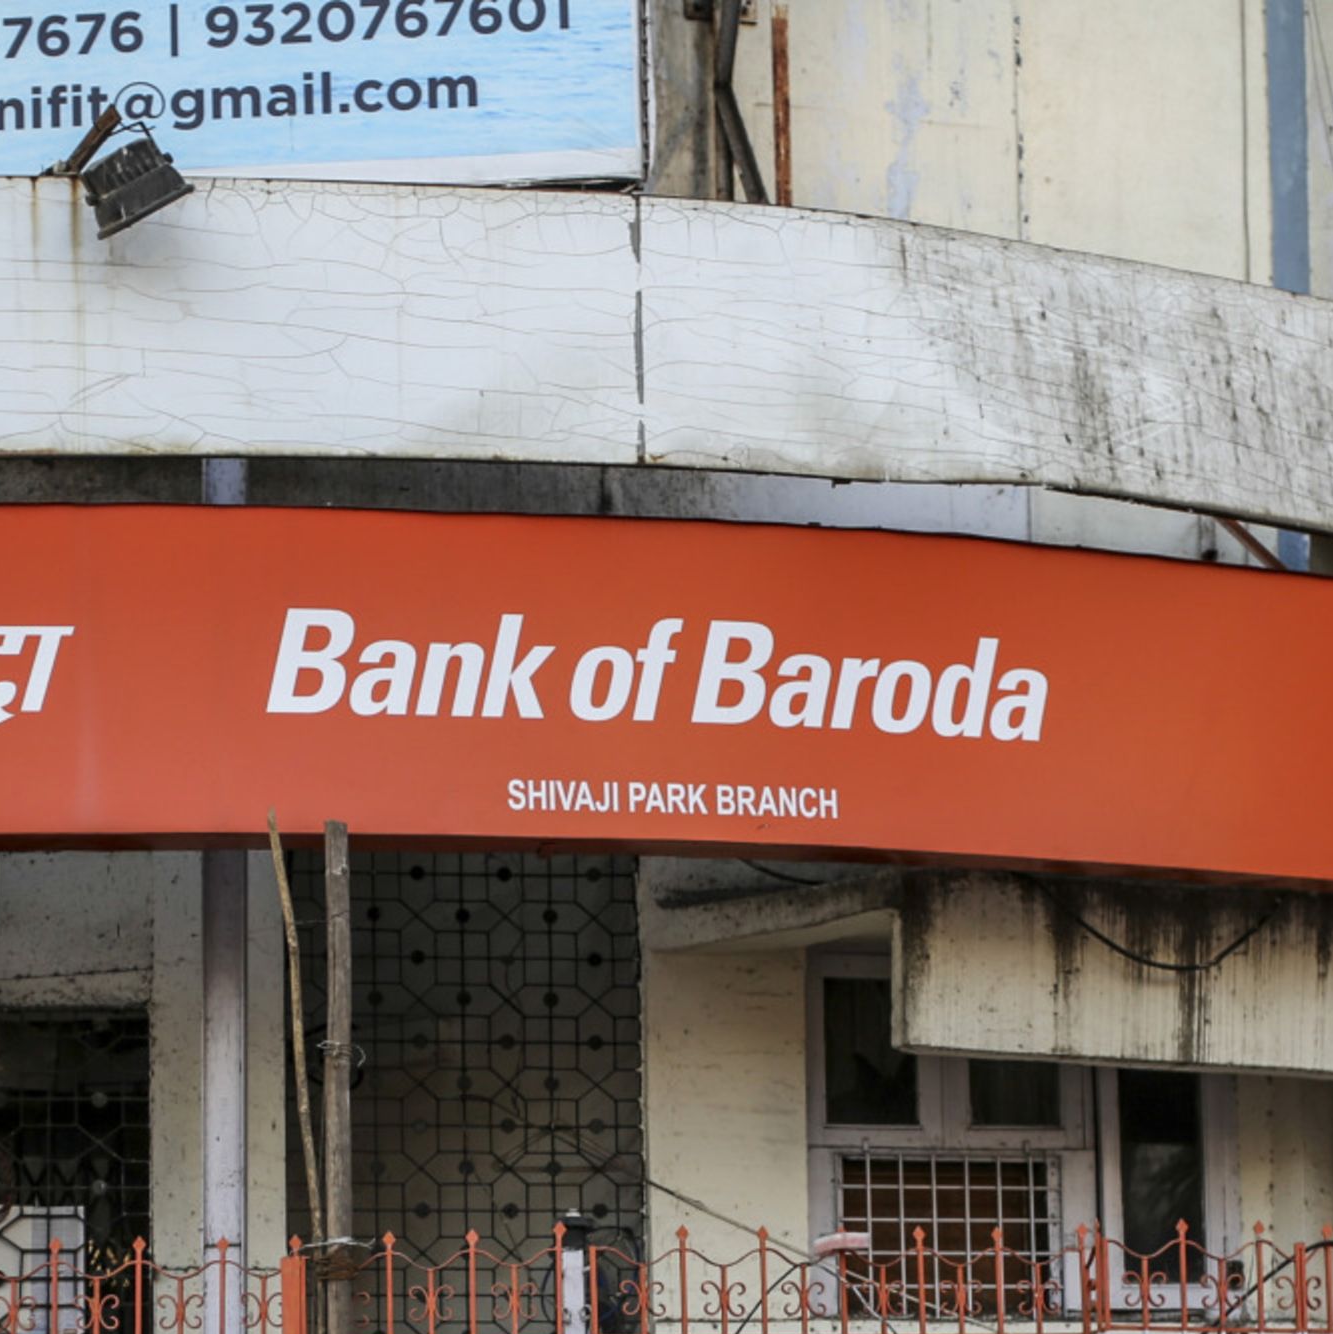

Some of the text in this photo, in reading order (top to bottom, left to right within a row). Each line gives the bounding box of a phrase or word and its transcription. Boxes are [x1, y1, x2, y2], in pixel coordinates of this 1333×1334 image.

[3, 12, 145, 60] 7676
[205, 0, 572, 48] 9320767601
[266, 607, 1049, 742] Bank of Baroda
[506, 779, 840, 820] SHIVAJI PARK BRANCH
